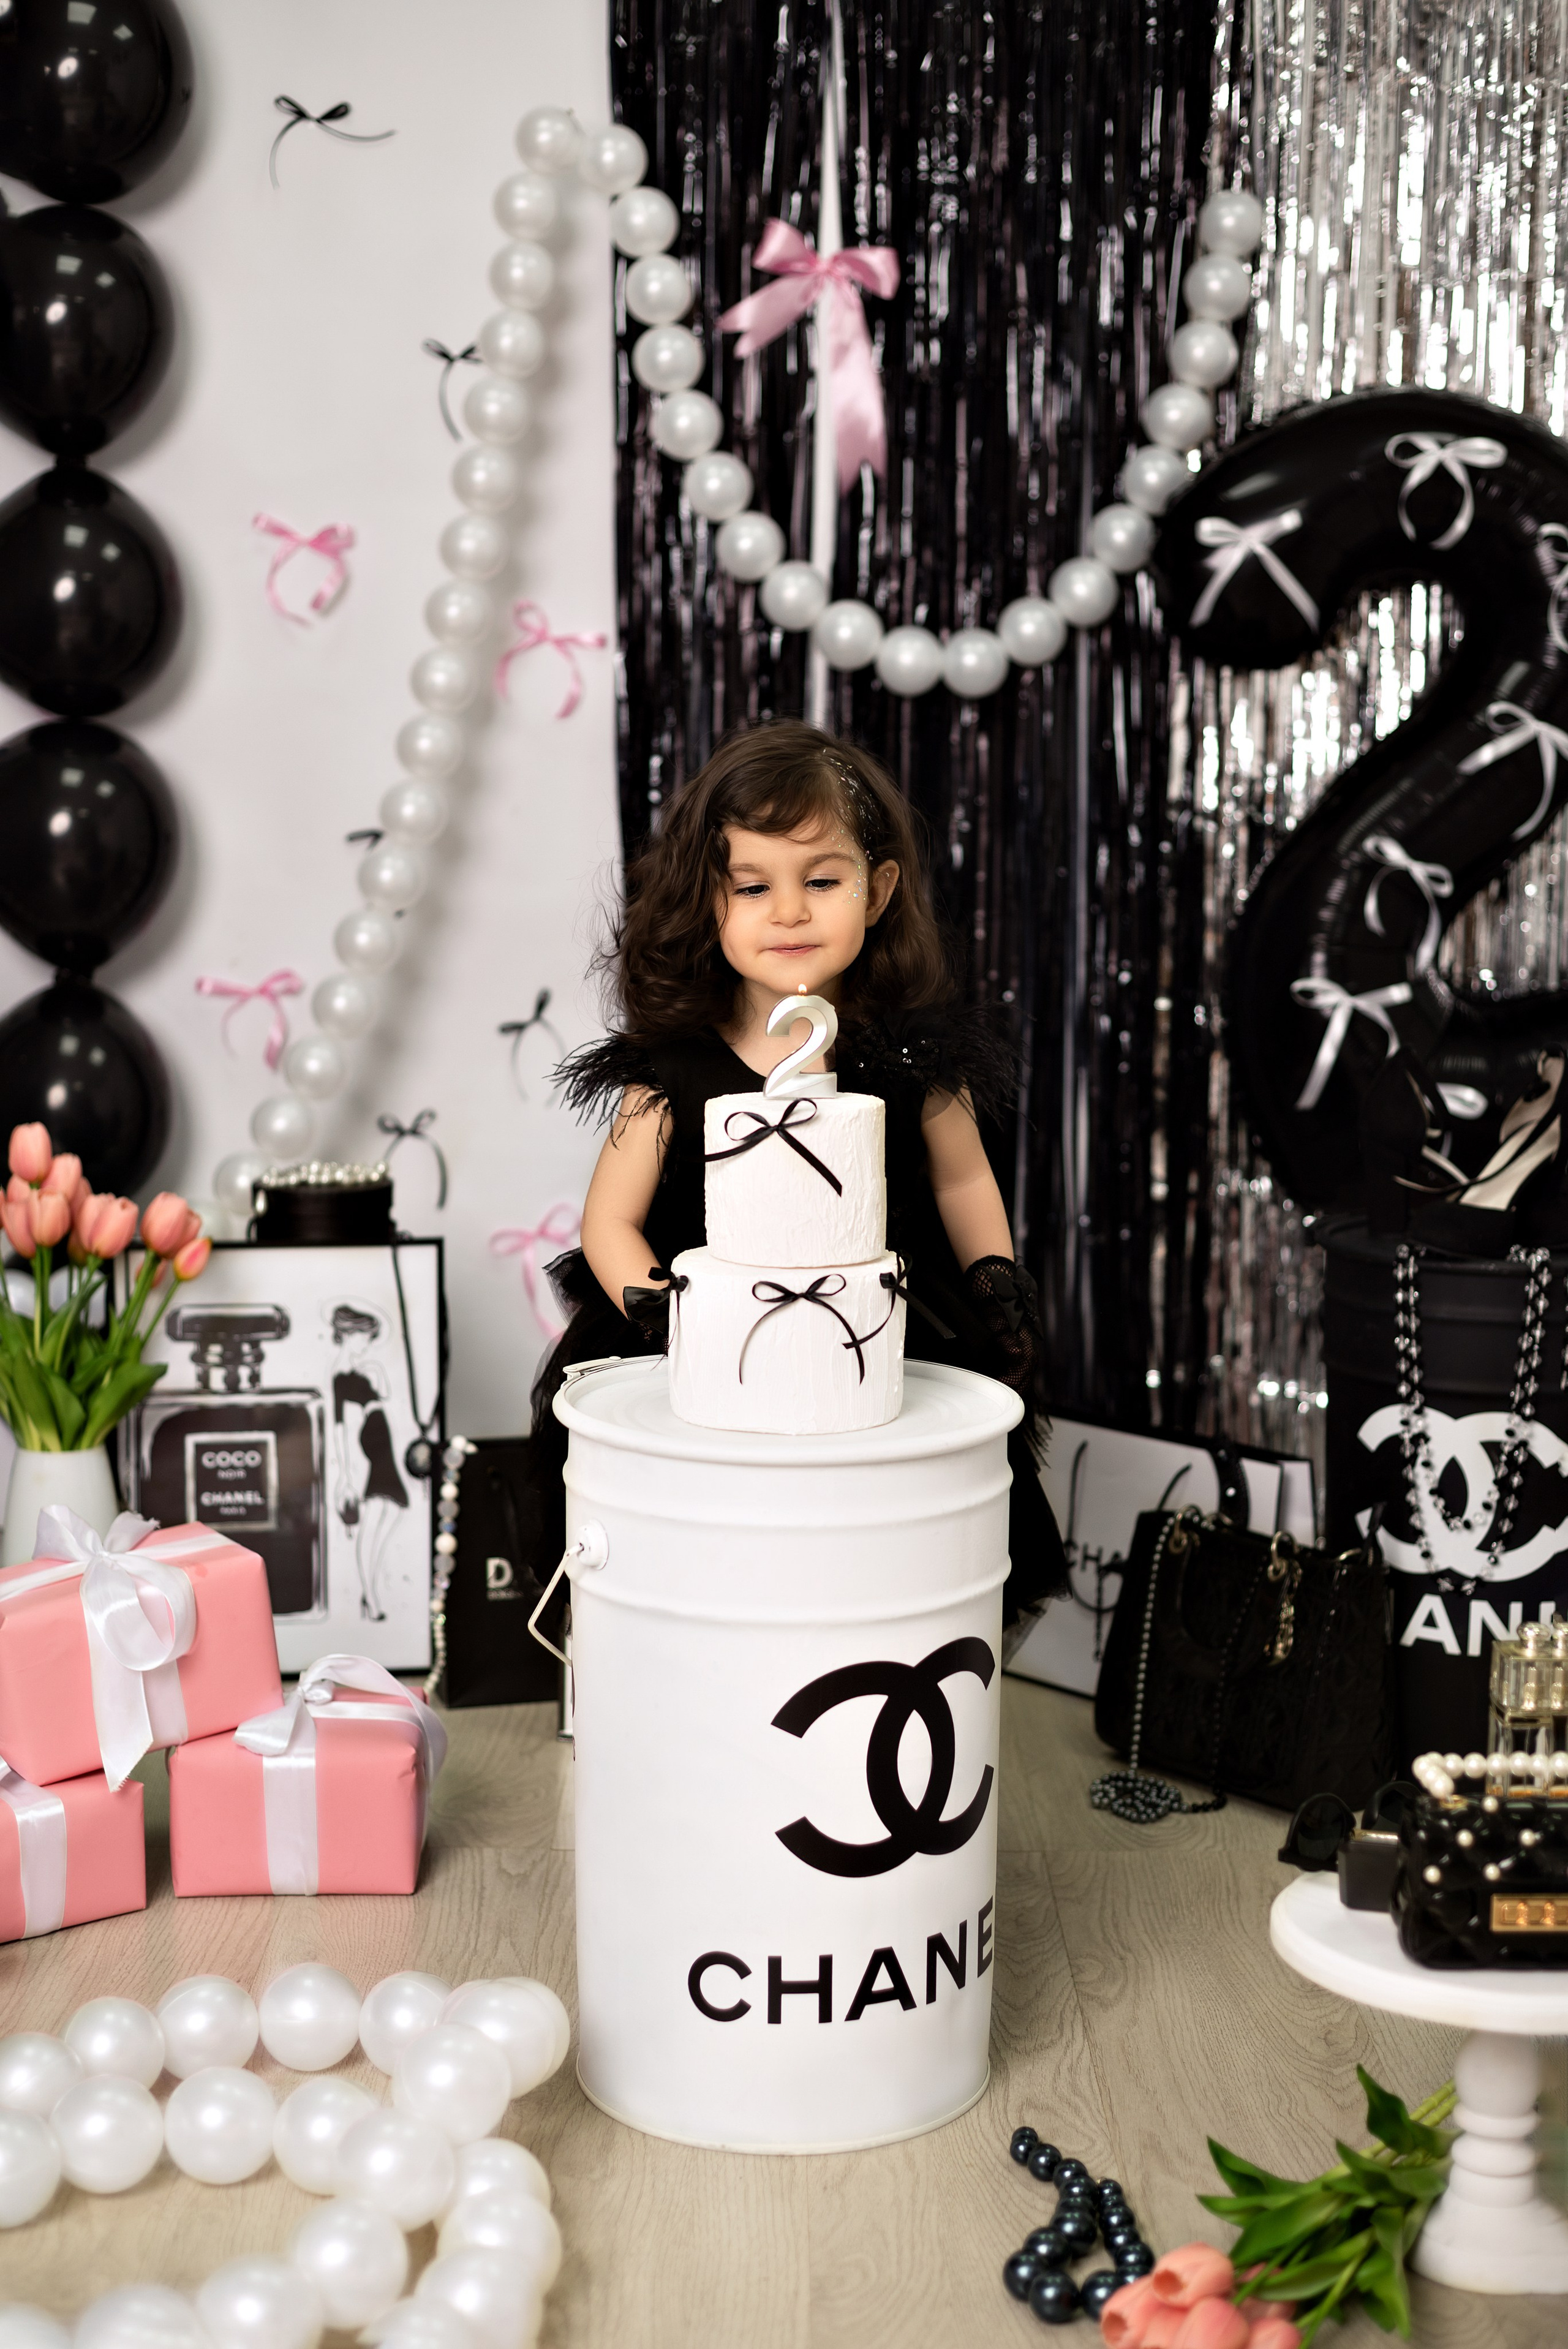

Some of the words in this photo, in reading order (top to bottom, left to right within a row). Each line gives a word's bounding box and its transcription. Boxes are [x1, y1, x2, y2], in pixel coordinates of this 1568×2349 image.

[202, 1450, 262, 1468] COCO
[201, 1490, 265, 1506] CHANEL
[688, 1895, 993, 2024] CHANE
